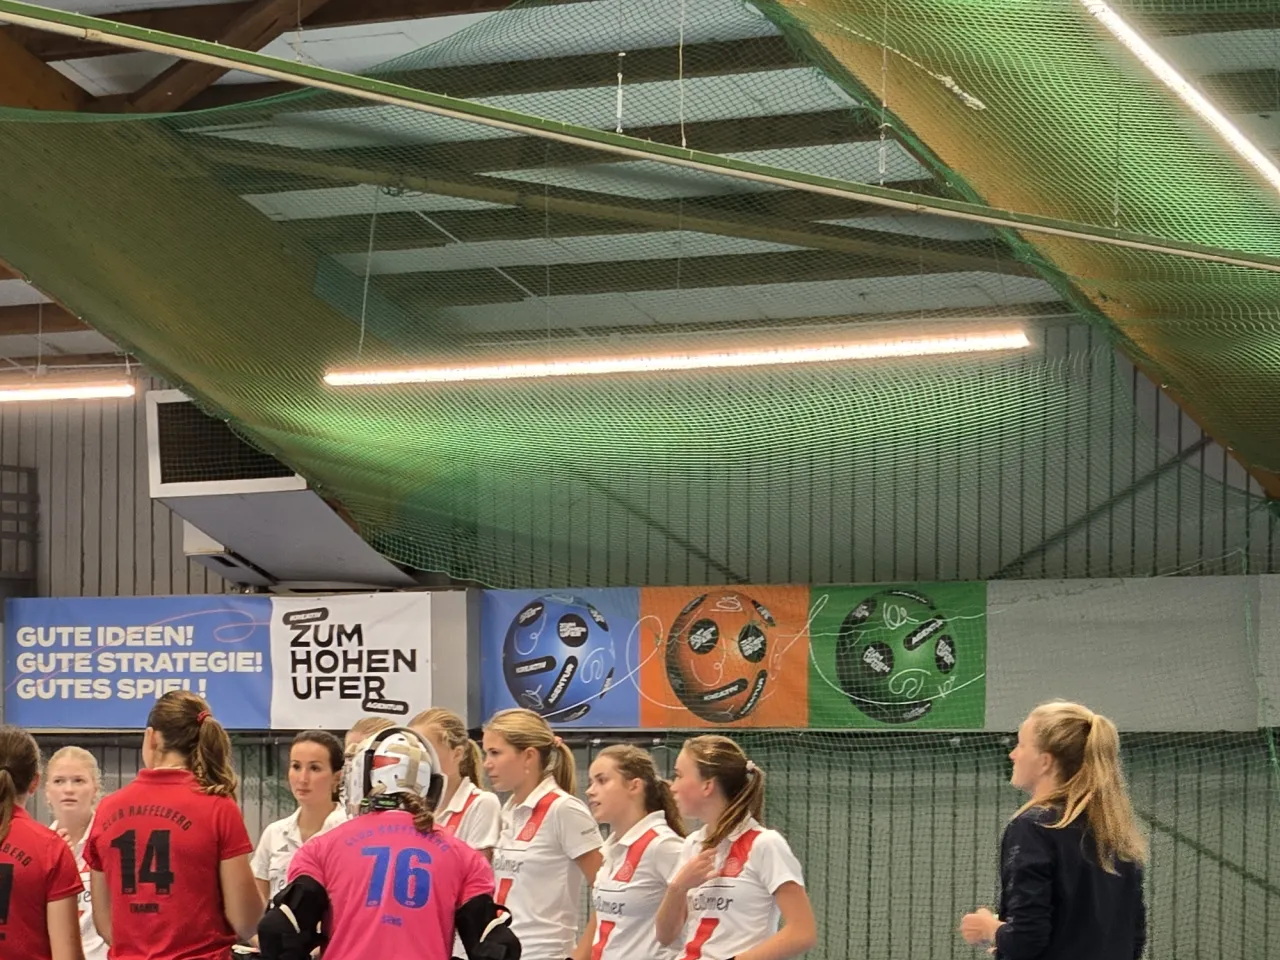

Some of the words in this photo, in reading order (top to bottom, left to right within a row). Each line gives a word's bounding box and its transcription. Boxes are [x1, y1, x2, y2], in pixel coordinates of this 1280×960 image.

[17, 627, 91, 647] GUTE
[97, 626, 194, 646] IDEEN!
[290, 624, 363, 648] ZUM
[17, 653, 91, 673] GUTE
[97, 652, 263, 673] STRATEGIE!
[291, 649, 416, 673] HOHEN
[17, 679, 112, 699] GUTES
[292, 676, 386, 700] UFER
[102, 809, 125, 831] CLUB
[128, 805, 193, 832] RAFFELBERG
[110, 829, 175, 895] 14
[361, 846, 433, 909] 76
